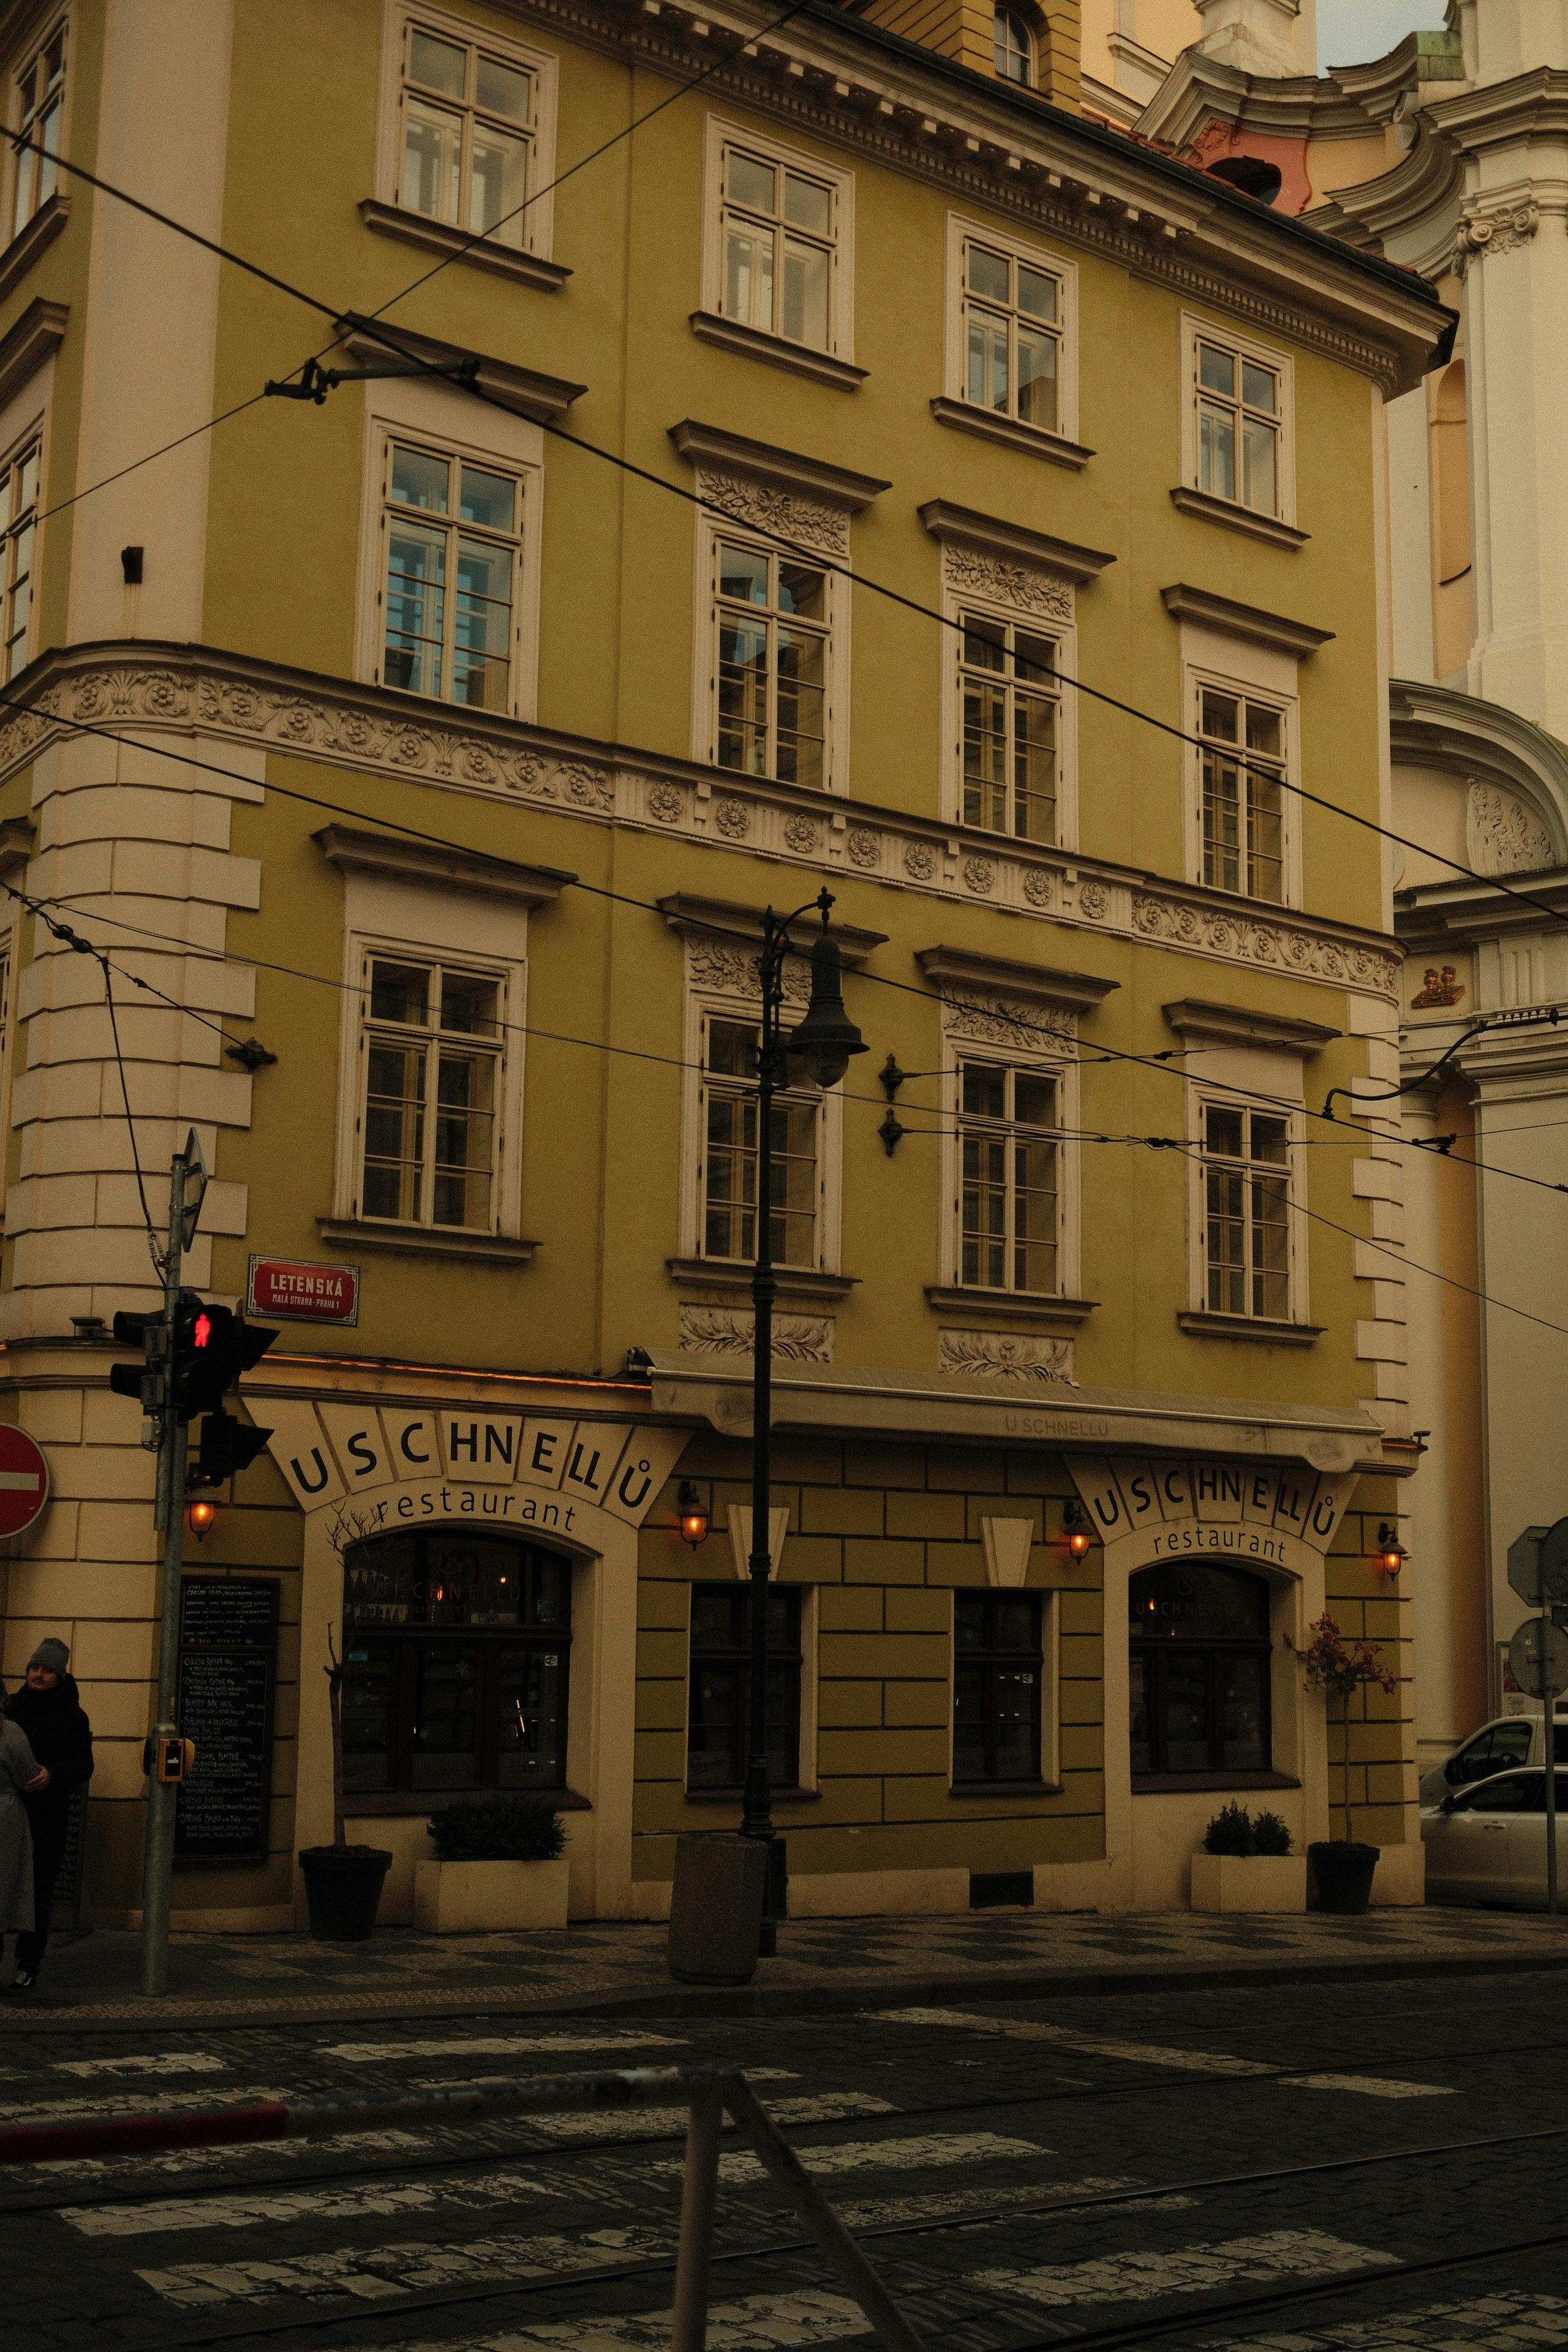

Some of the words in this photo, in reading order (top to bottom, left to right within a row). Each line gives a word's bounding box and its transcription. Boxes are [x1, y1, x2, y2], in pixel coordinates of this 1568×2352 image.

[270, 1273, 343, 1297] LETENSKÁ
[273, 1294, 288, 1303] MALÁ
[290, 1296, 312, 1306] STRANA
[316, 1298, 334, 1309] PRAHA
[1005, 1415, 1017, 1432] U
[290, 1447, 329, 1494] U
[347, 1422, 652, 1509] SCHNELLŮ
[377, 1487, 576, 1532] restaurant
[1094, 1489, 1119, 1526] U
[1131, 1469, 1335, 1536] SCHNELLŮ
[1154, 1526, 1285, 1562] restaurant
[180, 1812, 202, 1823] SPRING
